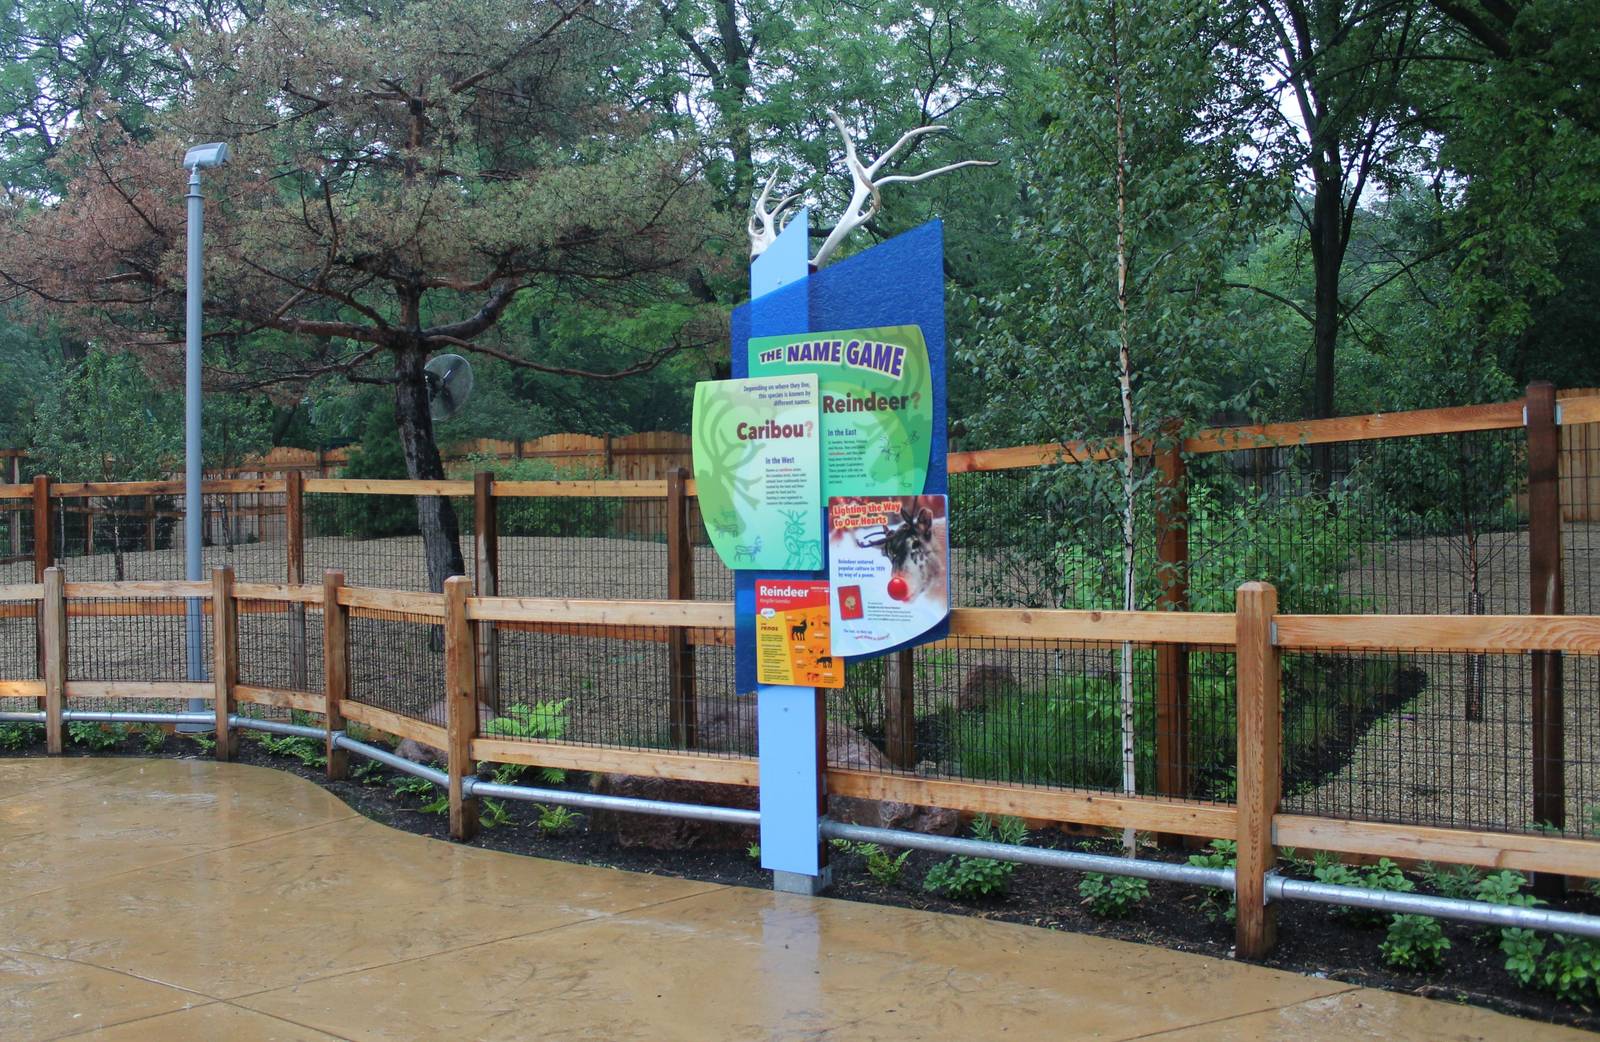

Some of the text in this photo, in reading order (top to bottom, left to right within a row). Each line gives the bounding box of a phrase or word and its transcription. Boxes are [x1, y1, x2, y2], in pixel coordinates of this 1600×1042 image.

[760, 340, 905, 377] THE NAME GAME
[823, 391, 921, 414] Reindeer?
[736, 419, 814, 441] Caribou?
[834, 428, 844, 436] the
[845, 428, 857, 436] East
[772, 456, 780, 464] the
[781, 456, 795, 464] West
[833, 501, 901, 515] Lighting the Way
[834, 516, 887, 527] to Our Hearts
[760, 585, 809, 598] Reindeer
